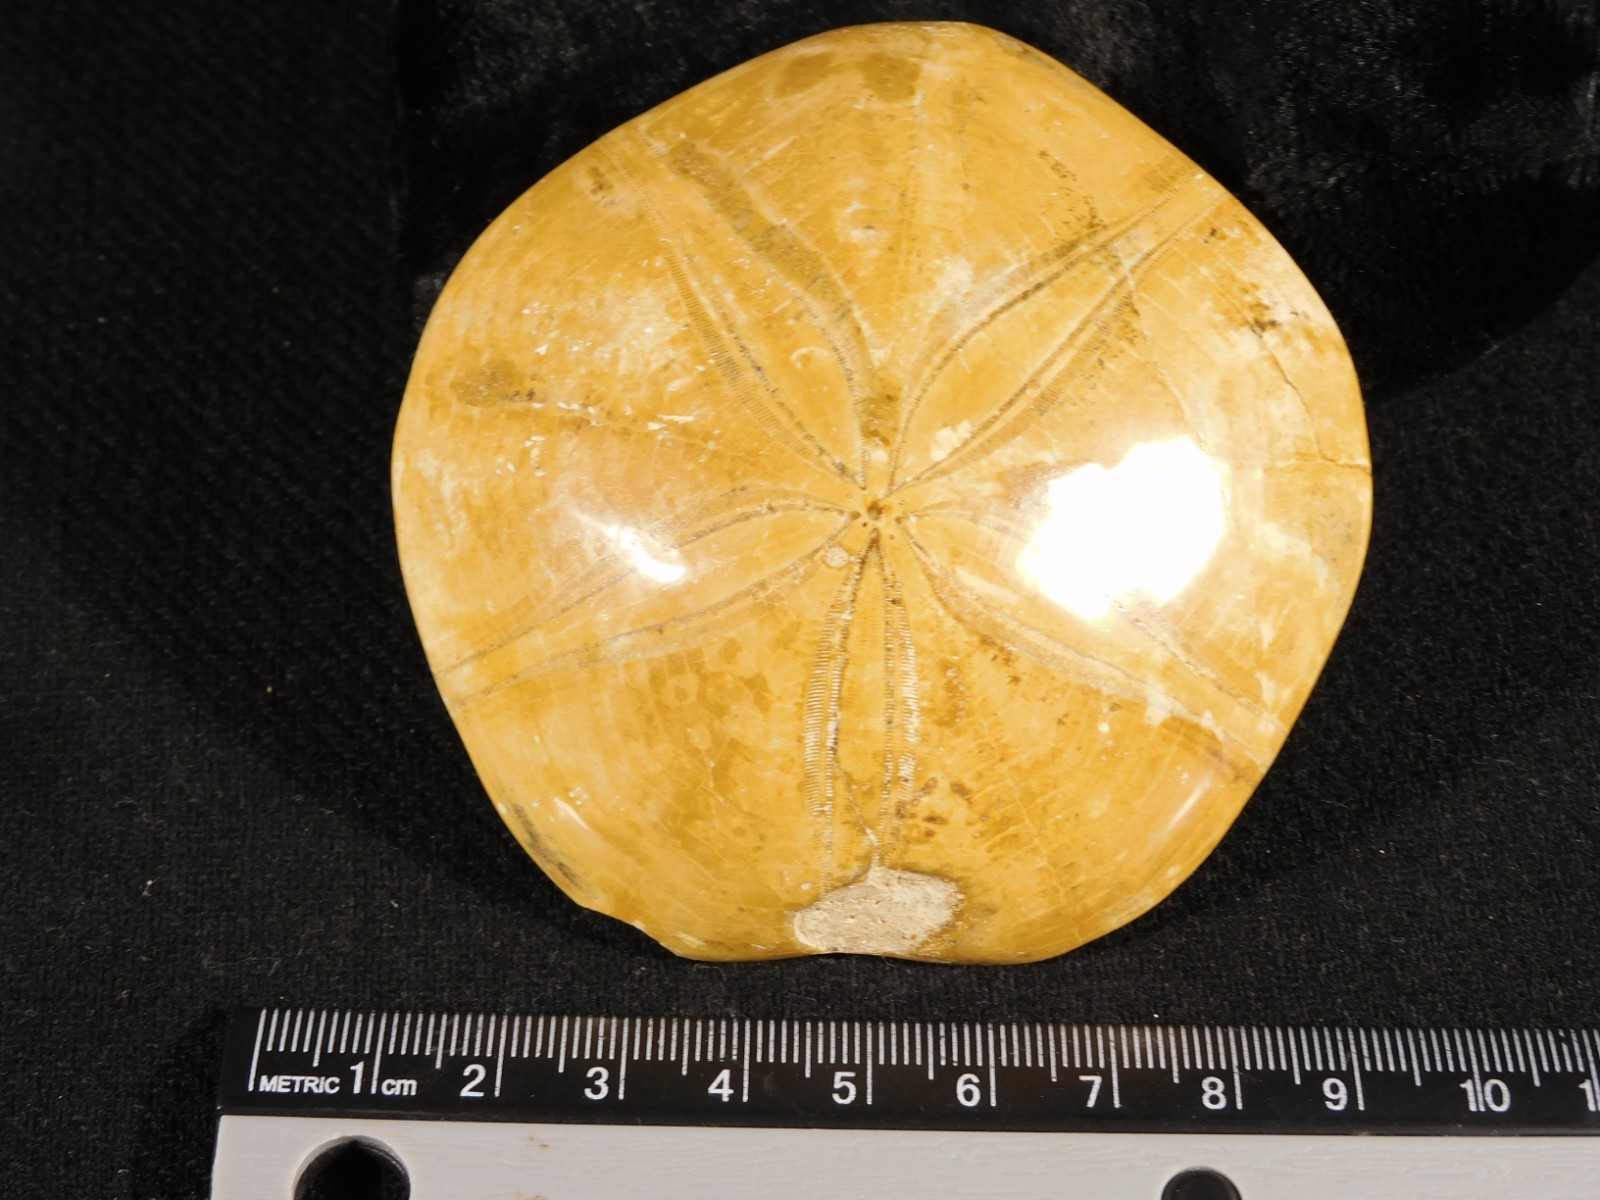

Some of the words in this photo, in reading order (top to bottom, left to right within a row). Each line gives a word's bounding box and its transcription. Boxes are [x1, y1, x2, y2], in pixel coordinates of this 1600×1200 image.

[259, 1074, 340, 1094] METRIC
[350, 1061, 364, 1094] 1
[381, 1078, 418, 1096] cm
[460, 1063, 486, 1097] 2
[584, 1066, 609, 1100] 3
[707, 1069, 734, 1102] 4
[832, 1071, 857, 1105] 5
[956, 1073, 981, 1107] 6
[1078, 1075, 1103, 1108] 7
[1201, 1076, 1227, 1110] 8
[1322, 1077, 1348, 1111] 9
[1459, 1079, 1511, 1112] 10
